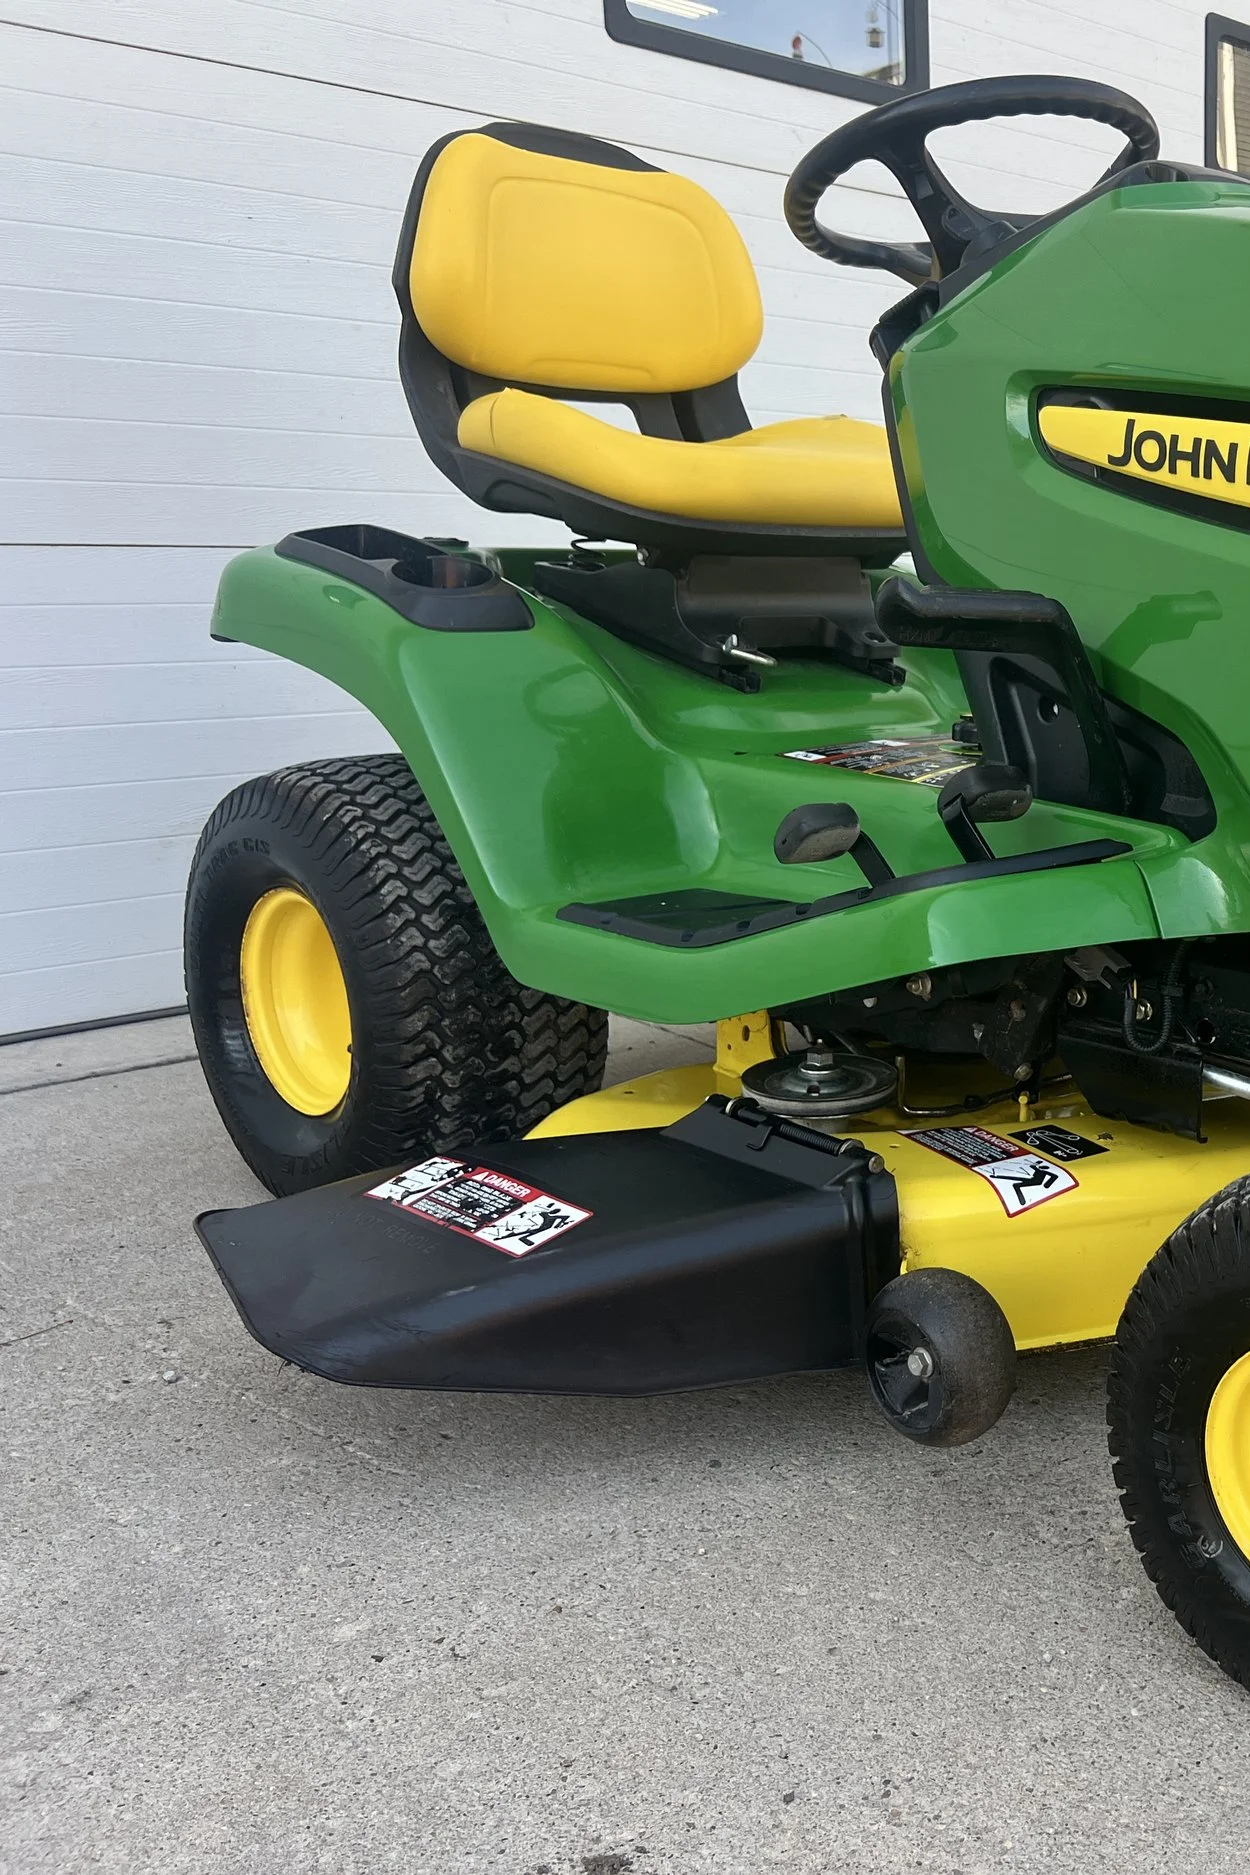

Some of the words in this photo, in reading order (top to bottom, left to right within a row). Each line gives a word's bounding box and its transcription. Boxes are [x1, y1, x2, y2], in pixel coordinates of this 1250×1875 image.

[1107, 418, 1239, 484] JOHN
[976, 1130, 1019, 1152] DANGER
[483, 1174, 532, 1198] DANGER
